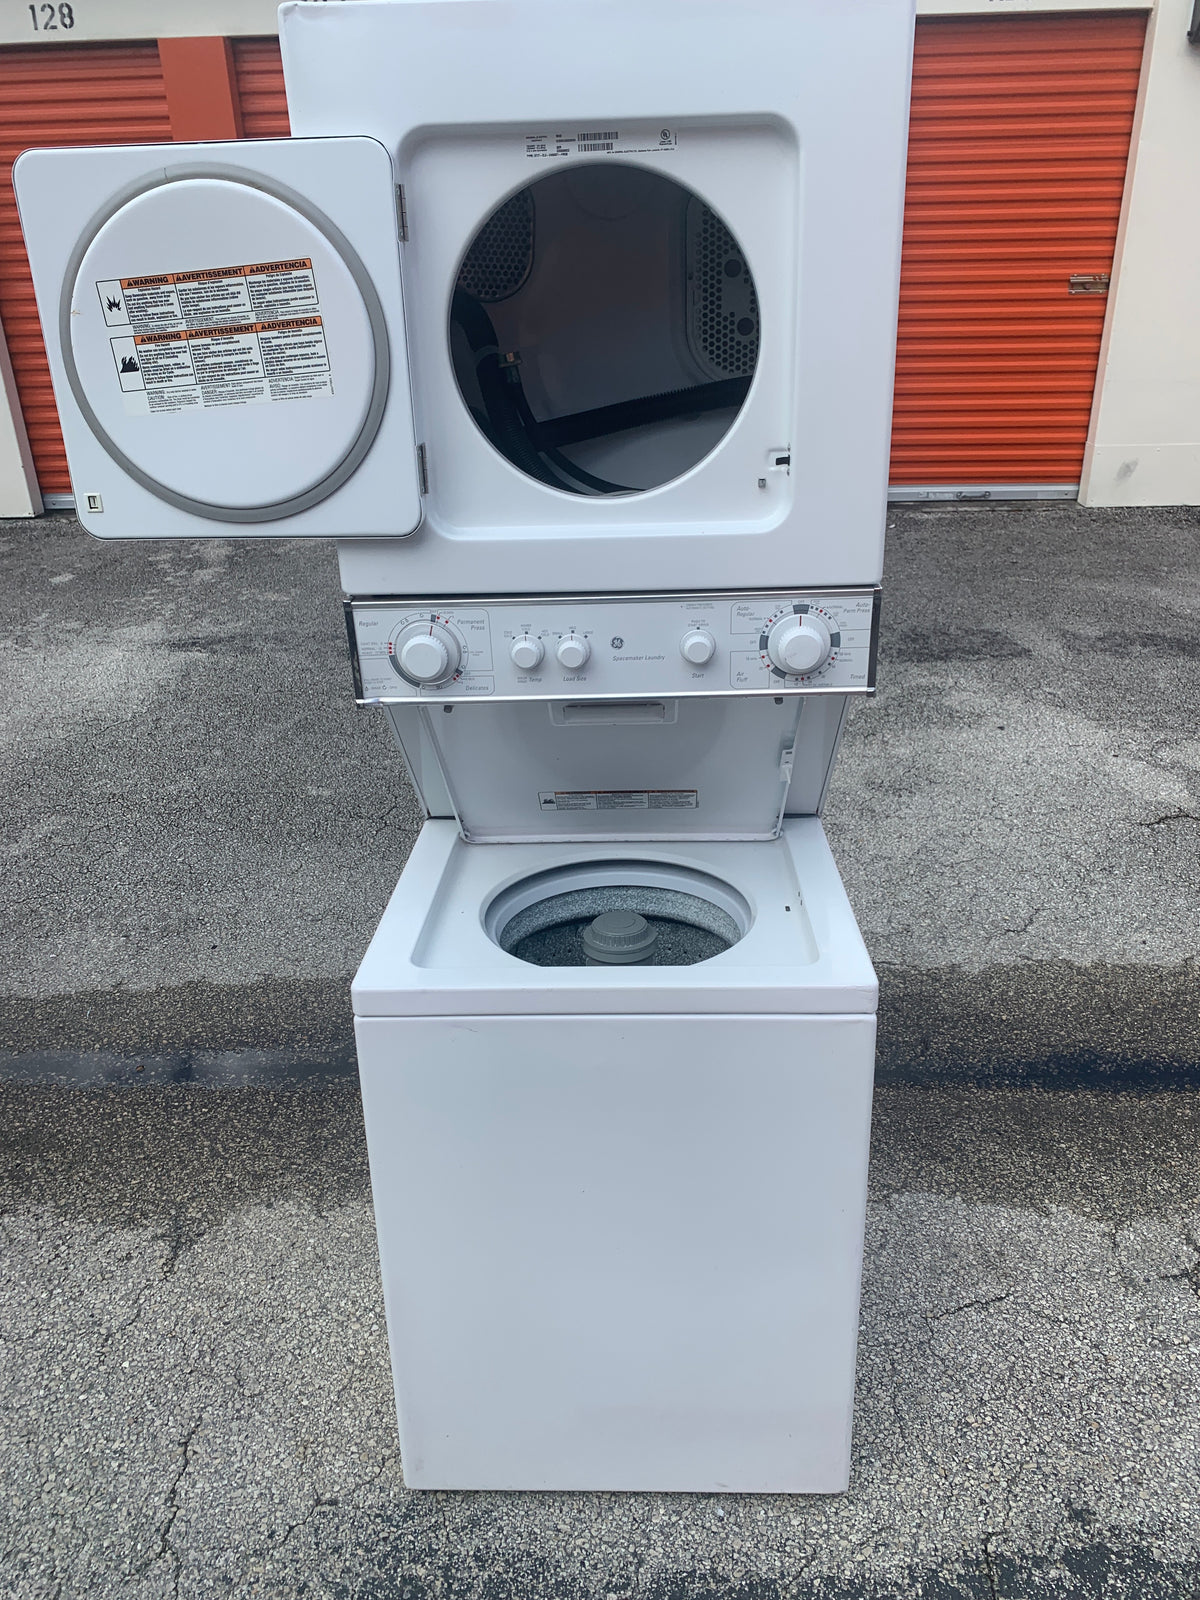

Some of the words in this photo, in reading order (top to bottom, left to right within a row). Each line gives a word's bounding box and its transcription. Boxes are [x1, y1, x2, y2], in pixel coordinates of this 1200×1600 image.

[29, 2, 75, 31] 128
[255, 260, 308, 273] ADVERTENCIA
[182, 268, 243, 280] AVERTISSEMENT
[132, 275, 169, 287] WARNING
[268, 318, 318, 330] ADVERTENCIA
[195, 325, 254, 337] AVERTISSEMENT
[146, 333, 182, 342] WARNING
[359, 620, 379, 628] Regular
[644, 654, 665, 662] Laundry
[528, 676, 543, 684] Temp
